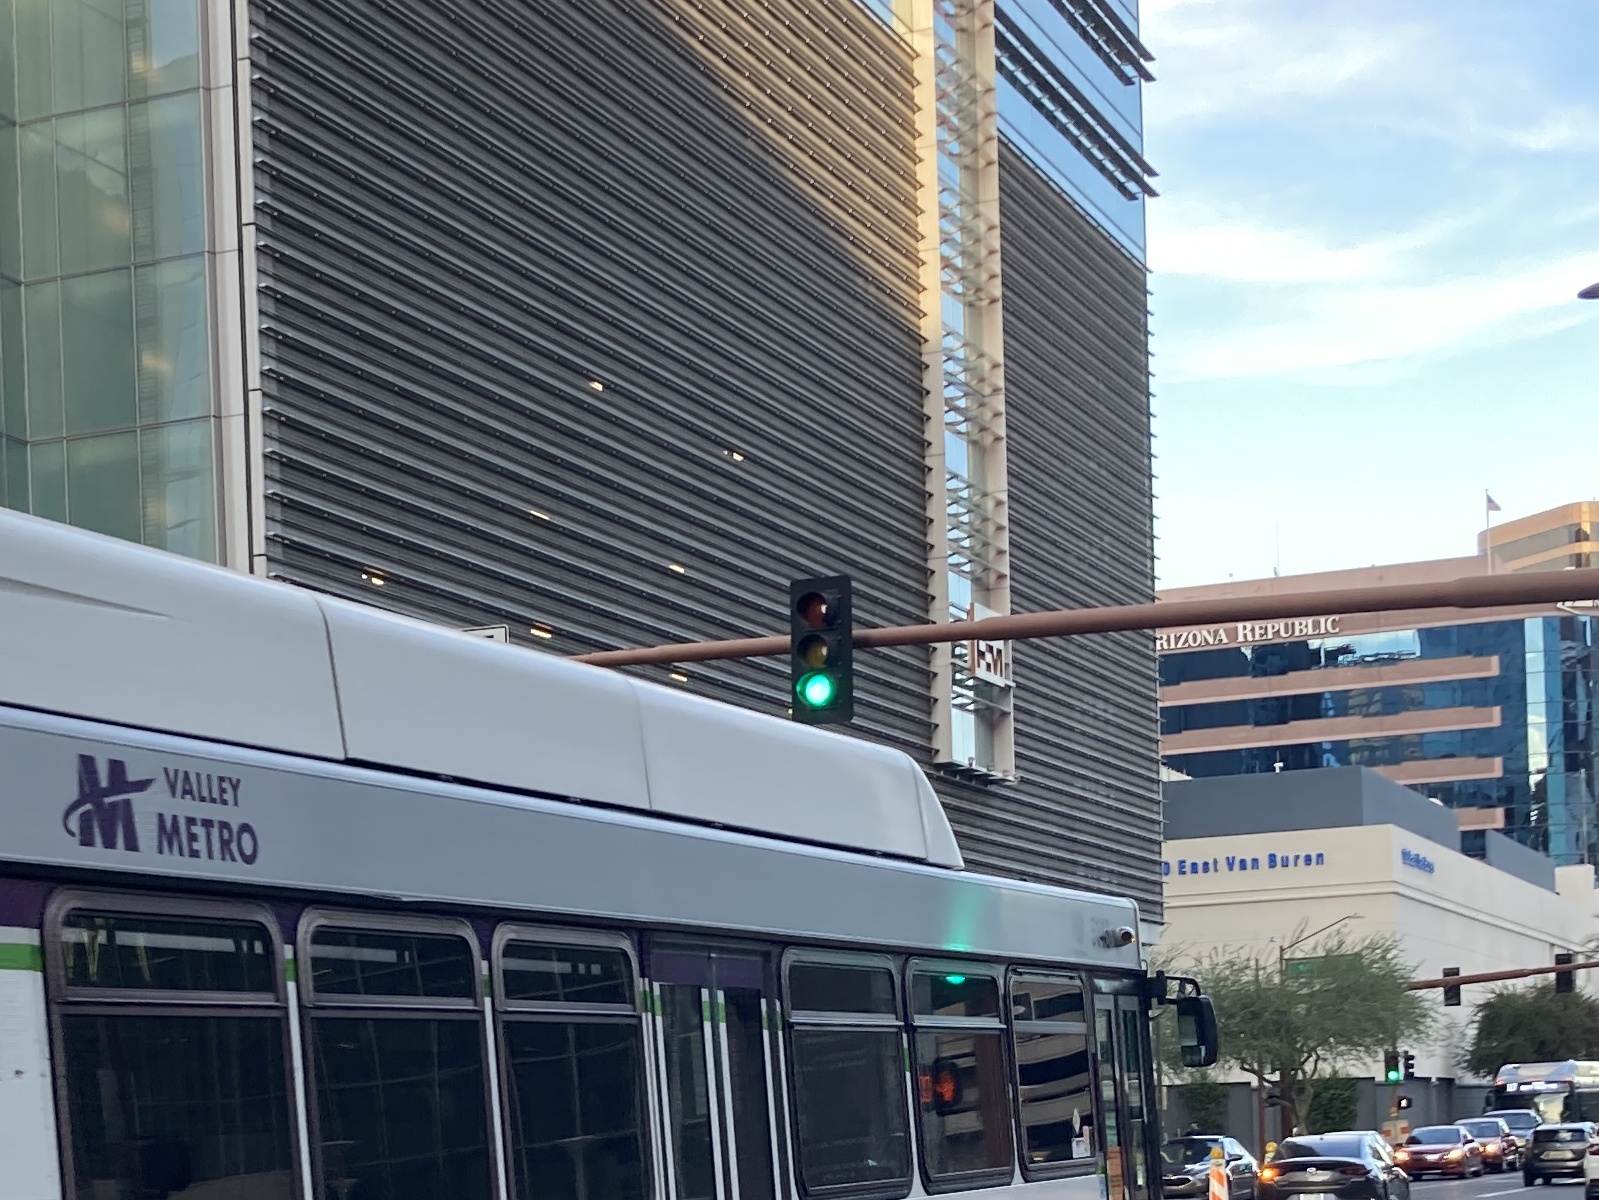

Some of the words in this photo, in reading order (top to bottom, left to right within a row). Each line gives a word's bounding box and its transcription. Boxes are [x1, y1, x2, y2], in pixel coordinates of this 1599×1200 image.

[1236, 616, 1340, 643] REPUBLIC
[162, 766, 242, 807] VALLEY
[157, 812, 259, 865] METRO
[1177, 857, 1218, 876] East
[1225, 855, 1260, 871] Van
[1267, 852, 1325, 869] Buren
